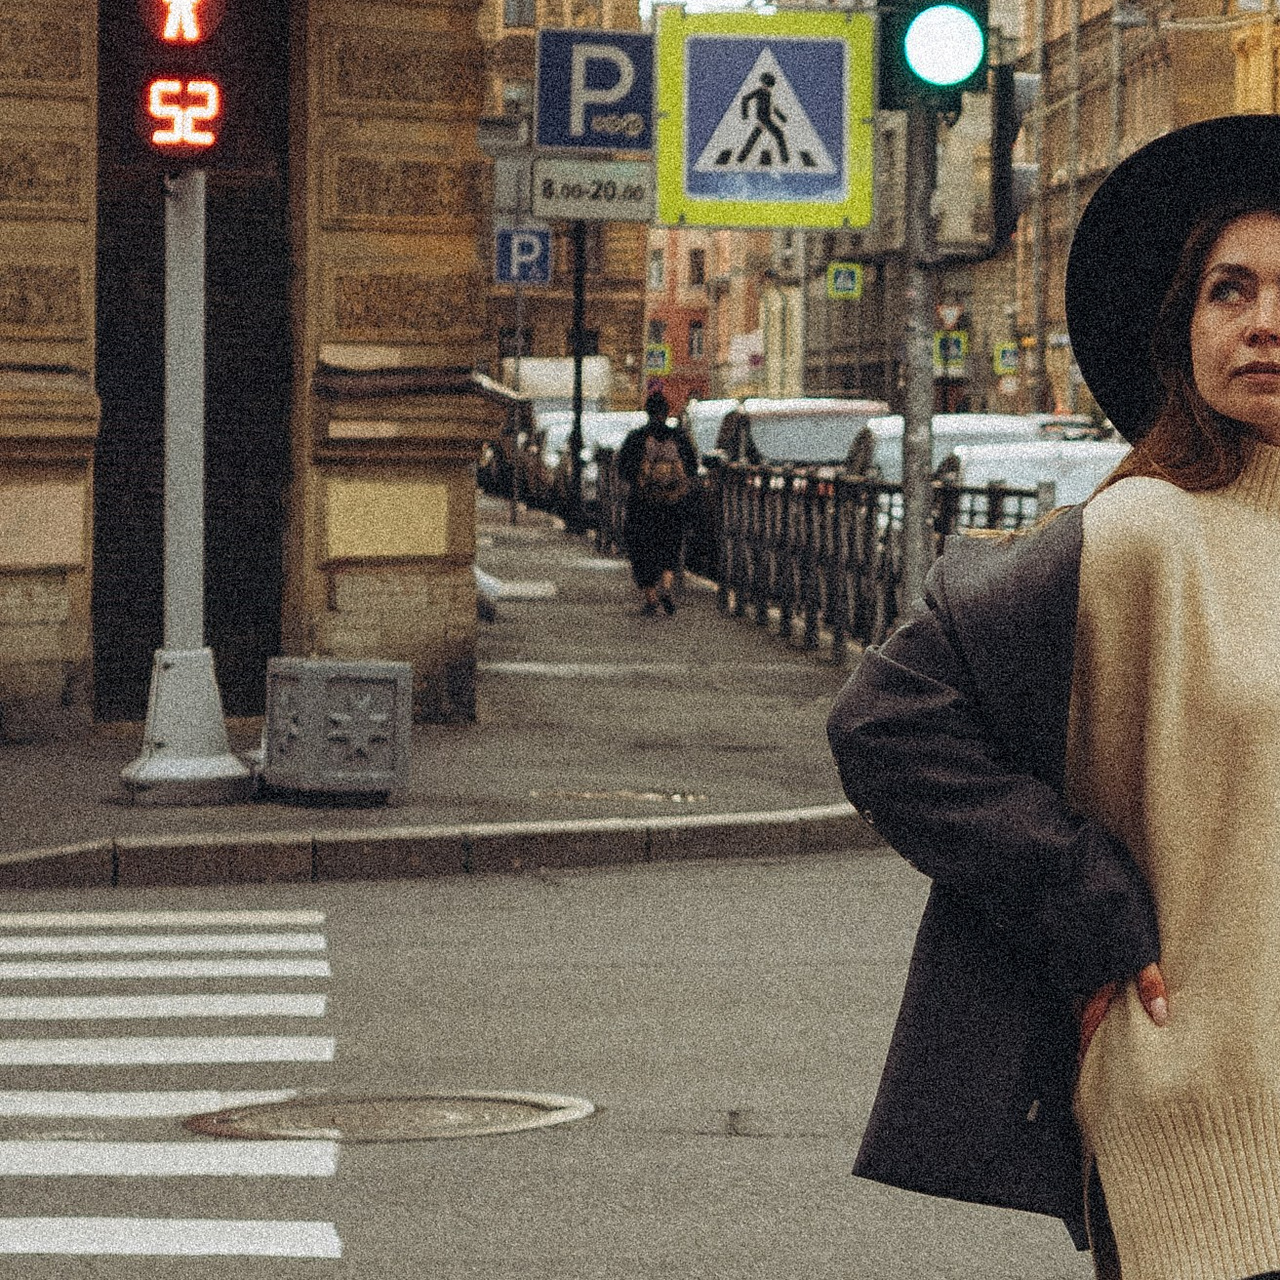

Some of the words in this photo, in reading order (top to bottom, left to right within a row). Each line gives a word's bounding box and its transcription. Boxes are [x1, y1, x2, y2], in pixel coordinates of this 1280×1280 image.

[149, 79, 219, 145] 52
[570, 44, 634, 136] P
[510, 234, 542, 277] P
